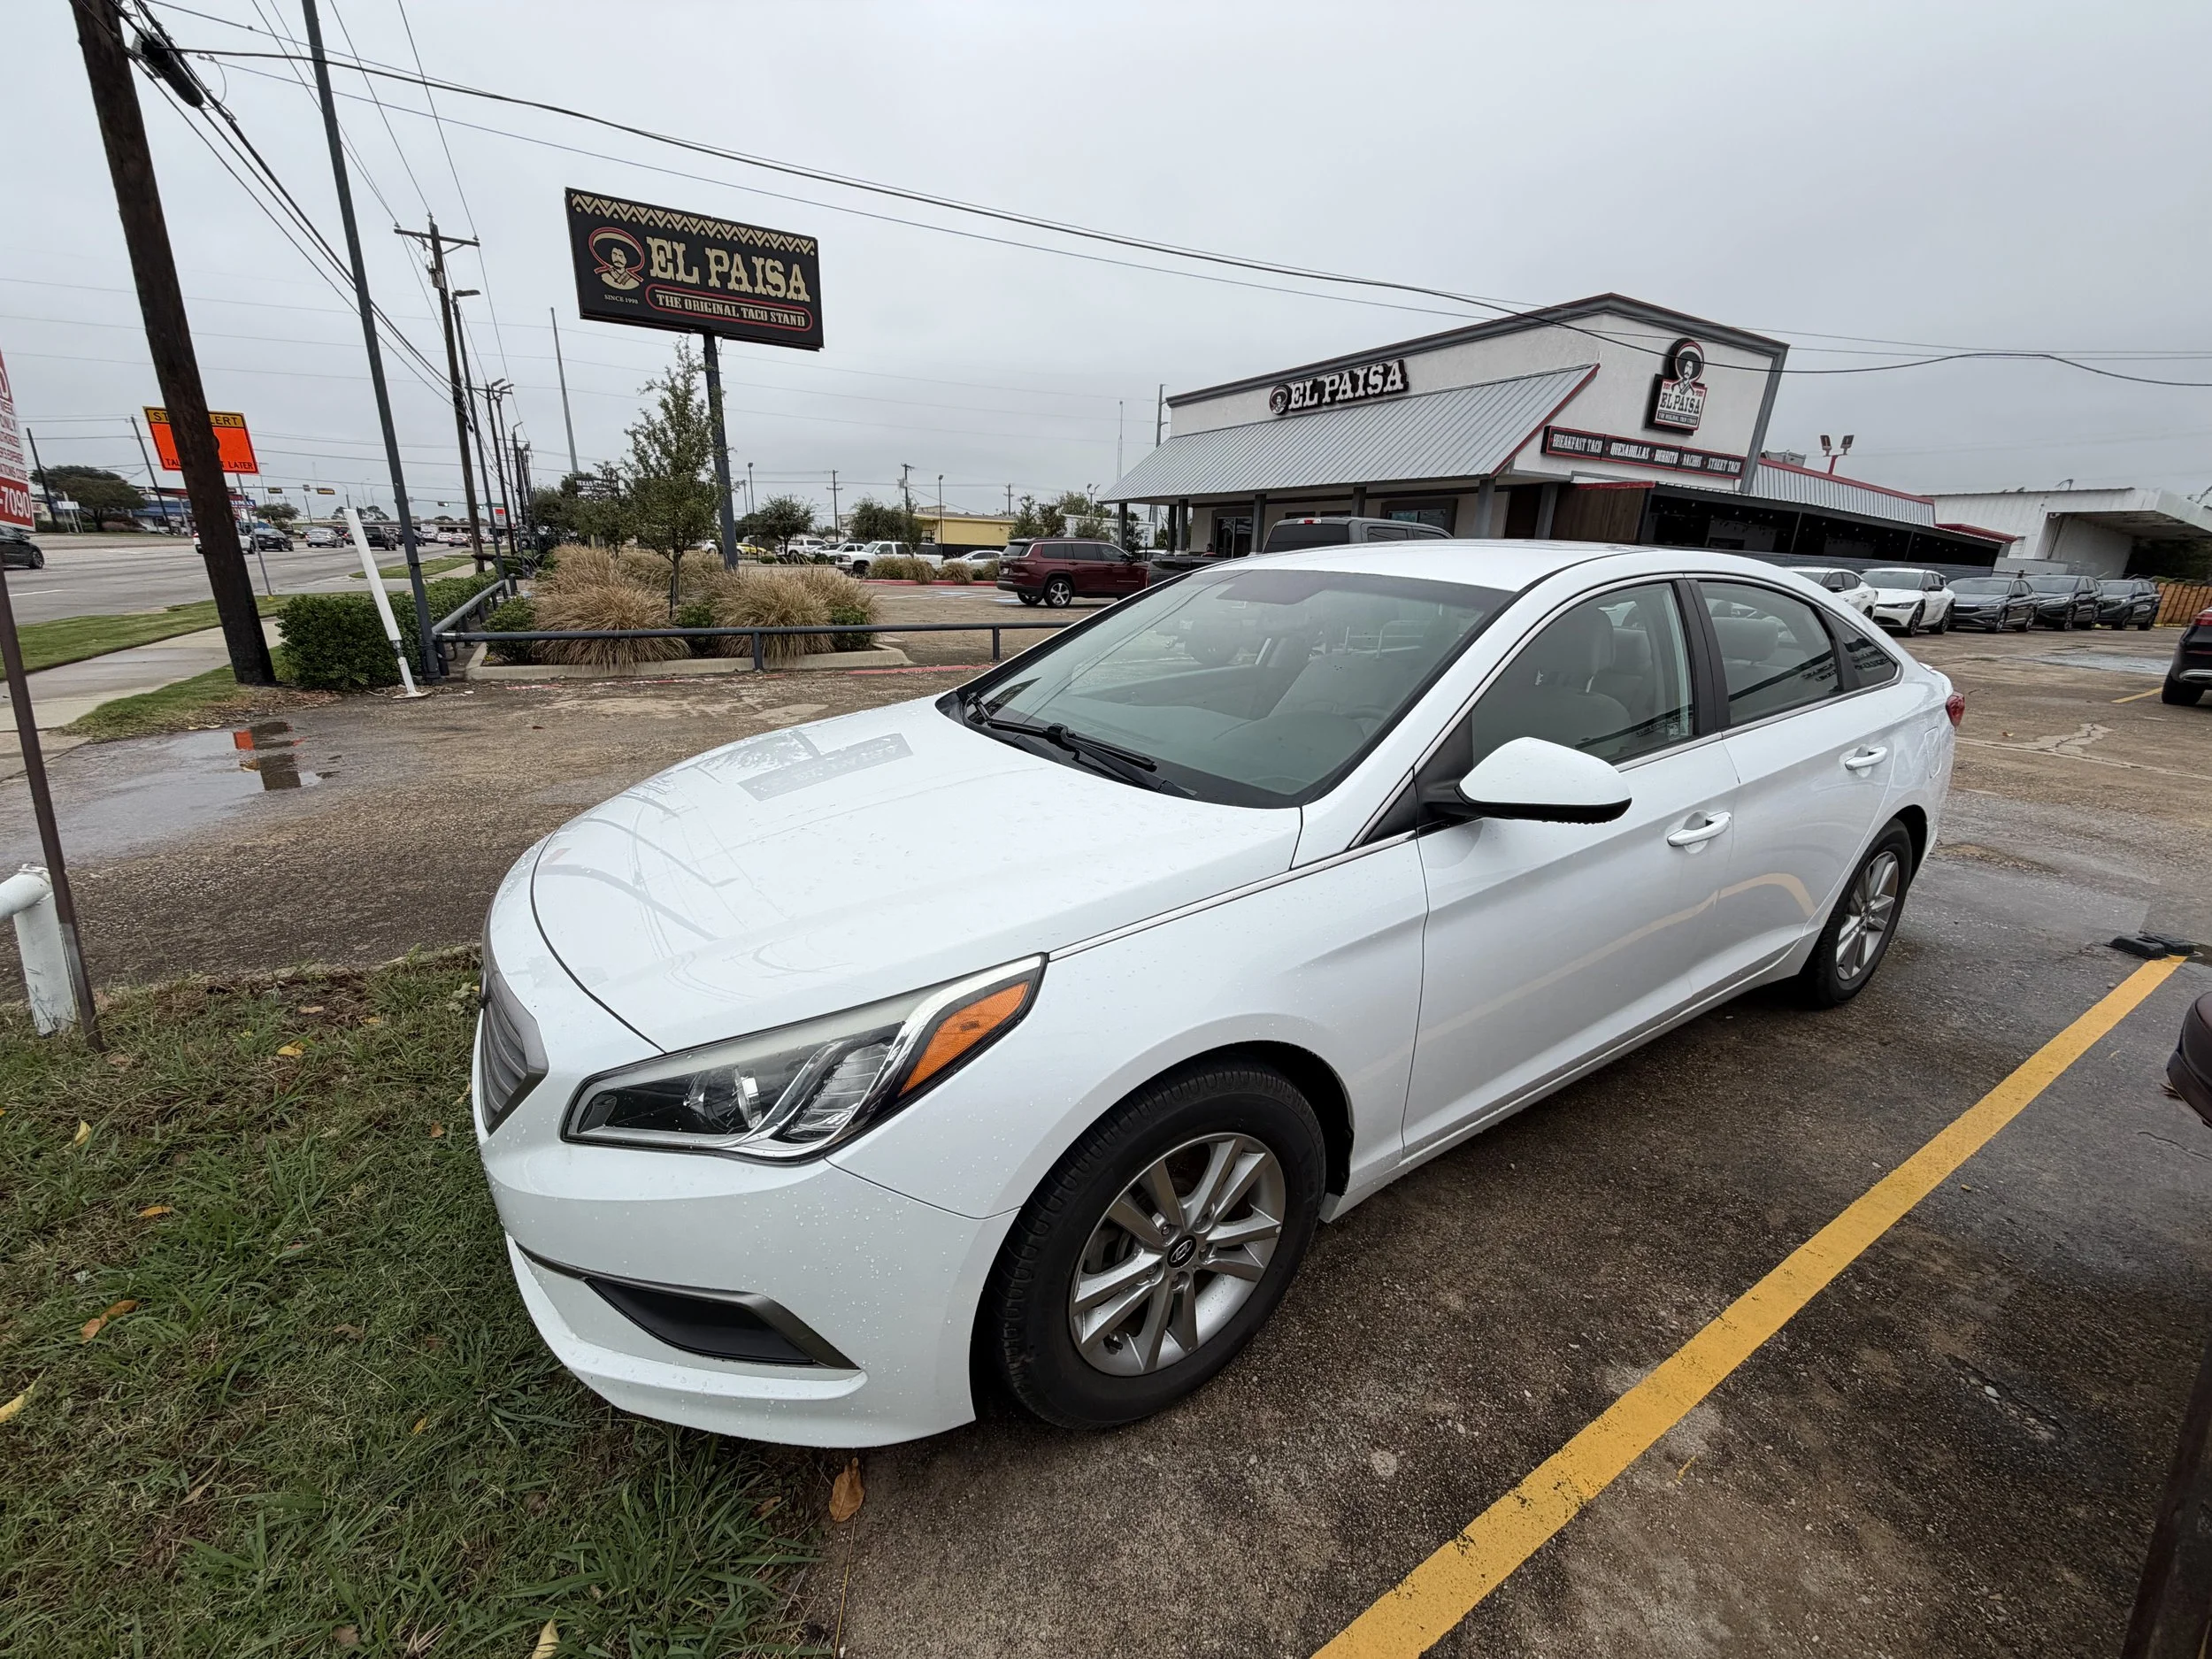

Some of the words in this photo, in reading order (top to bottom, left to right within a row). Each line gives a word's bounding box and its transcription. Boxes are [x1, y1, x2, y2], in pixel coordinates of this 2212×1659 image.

[646, 236, 701, 285] EL
[705, 247, 811, 303] PAISA
[604, 294, 624, 303] SINCE
[656, 294, 682, 309] THE
[684, 299, 740, 319] ORIGINAL
[741, 307, 768, 321] TACO
[770, 311, 805, 327] STAND
[1288, 379, 1318, 410] EL
[1321, 361, 1406, 403] PAISA
[1660, 392, 1672, 409] EL
[1672, 395, 1701, 415] PAISA
[210, 416, 239, 426] LERT
[227, 461, 254, 470] LATER
[1552, 434, 1587, 451] BREAKFAST
[1586, 439, 1603, 454] TACO
[1610, 442, 1650, 460] QUESADILLAS
[1707, 457, 1728, 472] STREET
[1727, 460, 1741, 473] TACO
